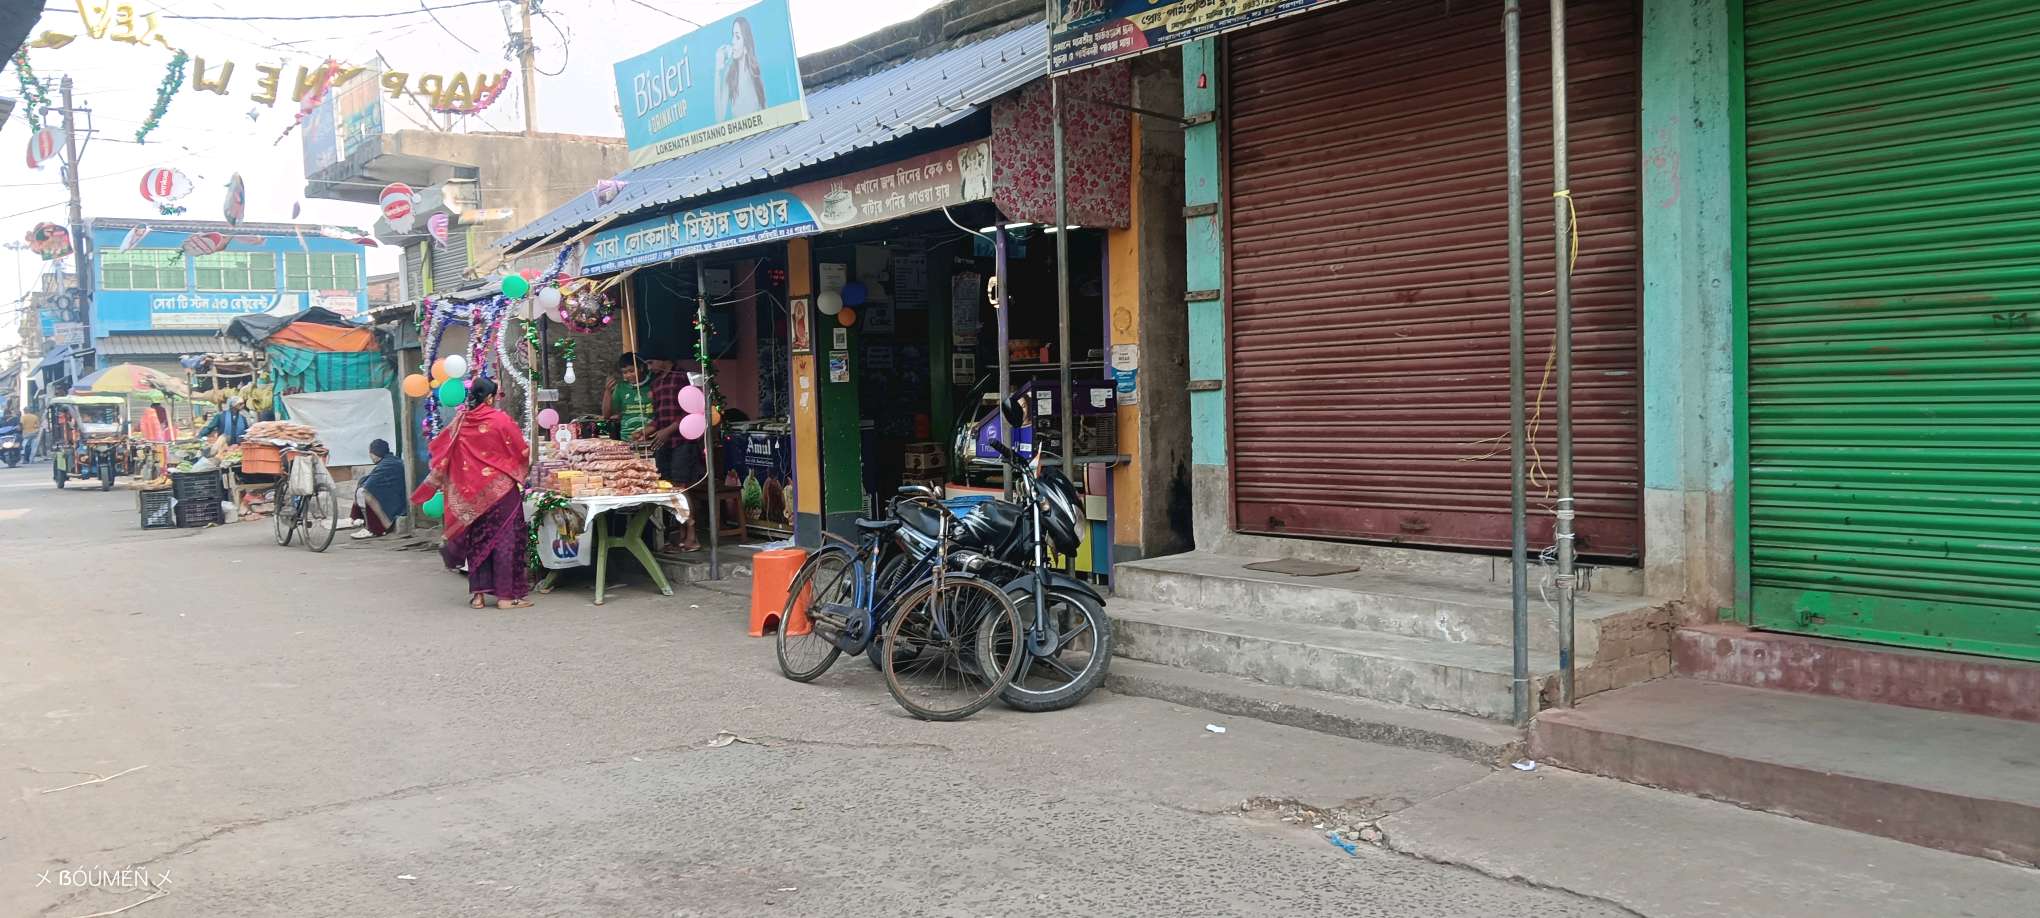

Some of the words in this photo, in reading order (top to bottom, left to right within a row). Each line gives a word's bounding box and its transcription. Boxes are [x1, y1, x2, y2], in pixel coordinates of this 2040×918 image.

[633, 45, 692, 118] Bisleri
[655, 136, 691, 156] LOKENATH
[690, 125, 727, 145] MISTANNO
[727, 114, 764, 135] BHANDER
[854, 178, 879, 195] এখানে
[896, 166, 921, 187] দিনের
[923, 162, 944, 180] কেক
[945, 159, 953, 172] ও
[884, 192, 906, 213] পনির
[593, 235, 620, 260] বাবা
[624, 220, 681, 255] লোকনাথ
[746, 436, 771, 456] Amul
